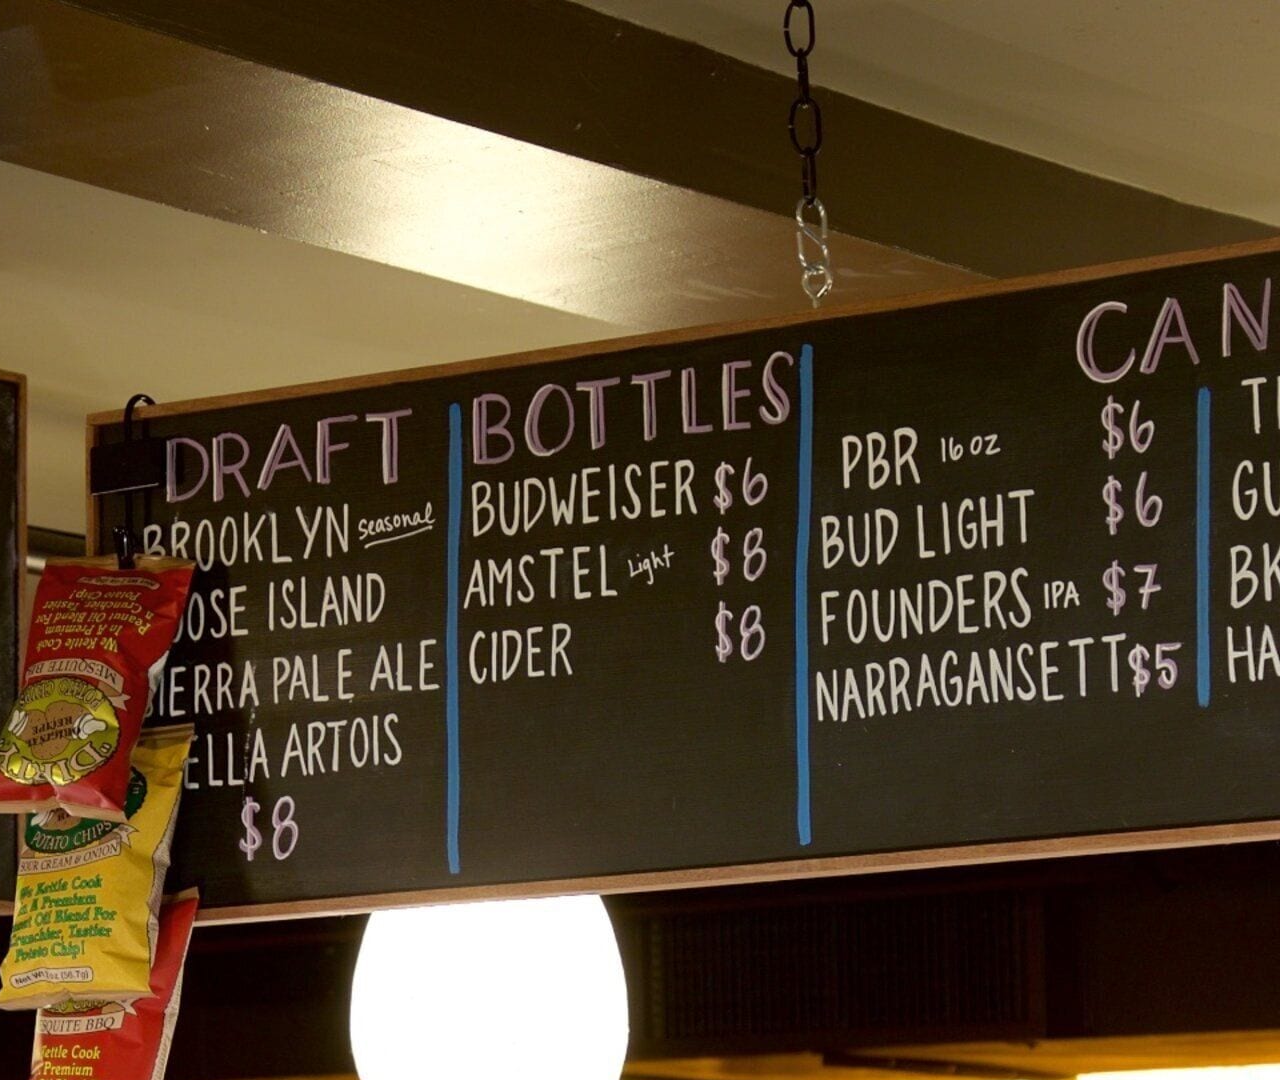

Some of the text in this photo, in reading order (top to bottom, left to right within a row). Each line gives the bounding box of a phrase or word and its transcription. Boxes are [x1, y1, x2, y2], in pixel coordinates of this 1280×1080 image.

[472, 351, 794, 465] BOTTLES
[167, 409, 412, 501] DRAFT
[842, 427, 920, 490] PBR
[1101, 395, 1155, 459] $6
[471, 460, 768, 537] BUDWEISER $6
[821, 471, 1163, 569] BUD LIGHT $6
[143, 502, 436, 571] BROOKLYN seasonal
[464, 528, 768, 609] AMSTEL Light $8
[269, 573, 385, 632] ISLAND
[821, 560, 1161, 645] FOUNDERS IPA $7
[49, 659, 118, 685] MESQUITE
[273, 649, 354, 703] PALE
[371, 639, 439, 691] ALE
[468, 601, 765, 684] CIDER $8
[816, 634, 1182, 722] NARRAGANSETT $5
[281, 713, 402, 778] ARTOIS
[31, 821, 111, 849] POTATO CHIPS
[41, 857, 72, 870] CREAM
[84, 843, 119, 861] ONION
[239, 796, 299, 861] $8
[72, 874, 102, 889] Cook
[72, 1045, 101, 1059] Cook
[85, 1016, 115, 1030] BBQ
[44, 1062, 93, 1076] Premium
